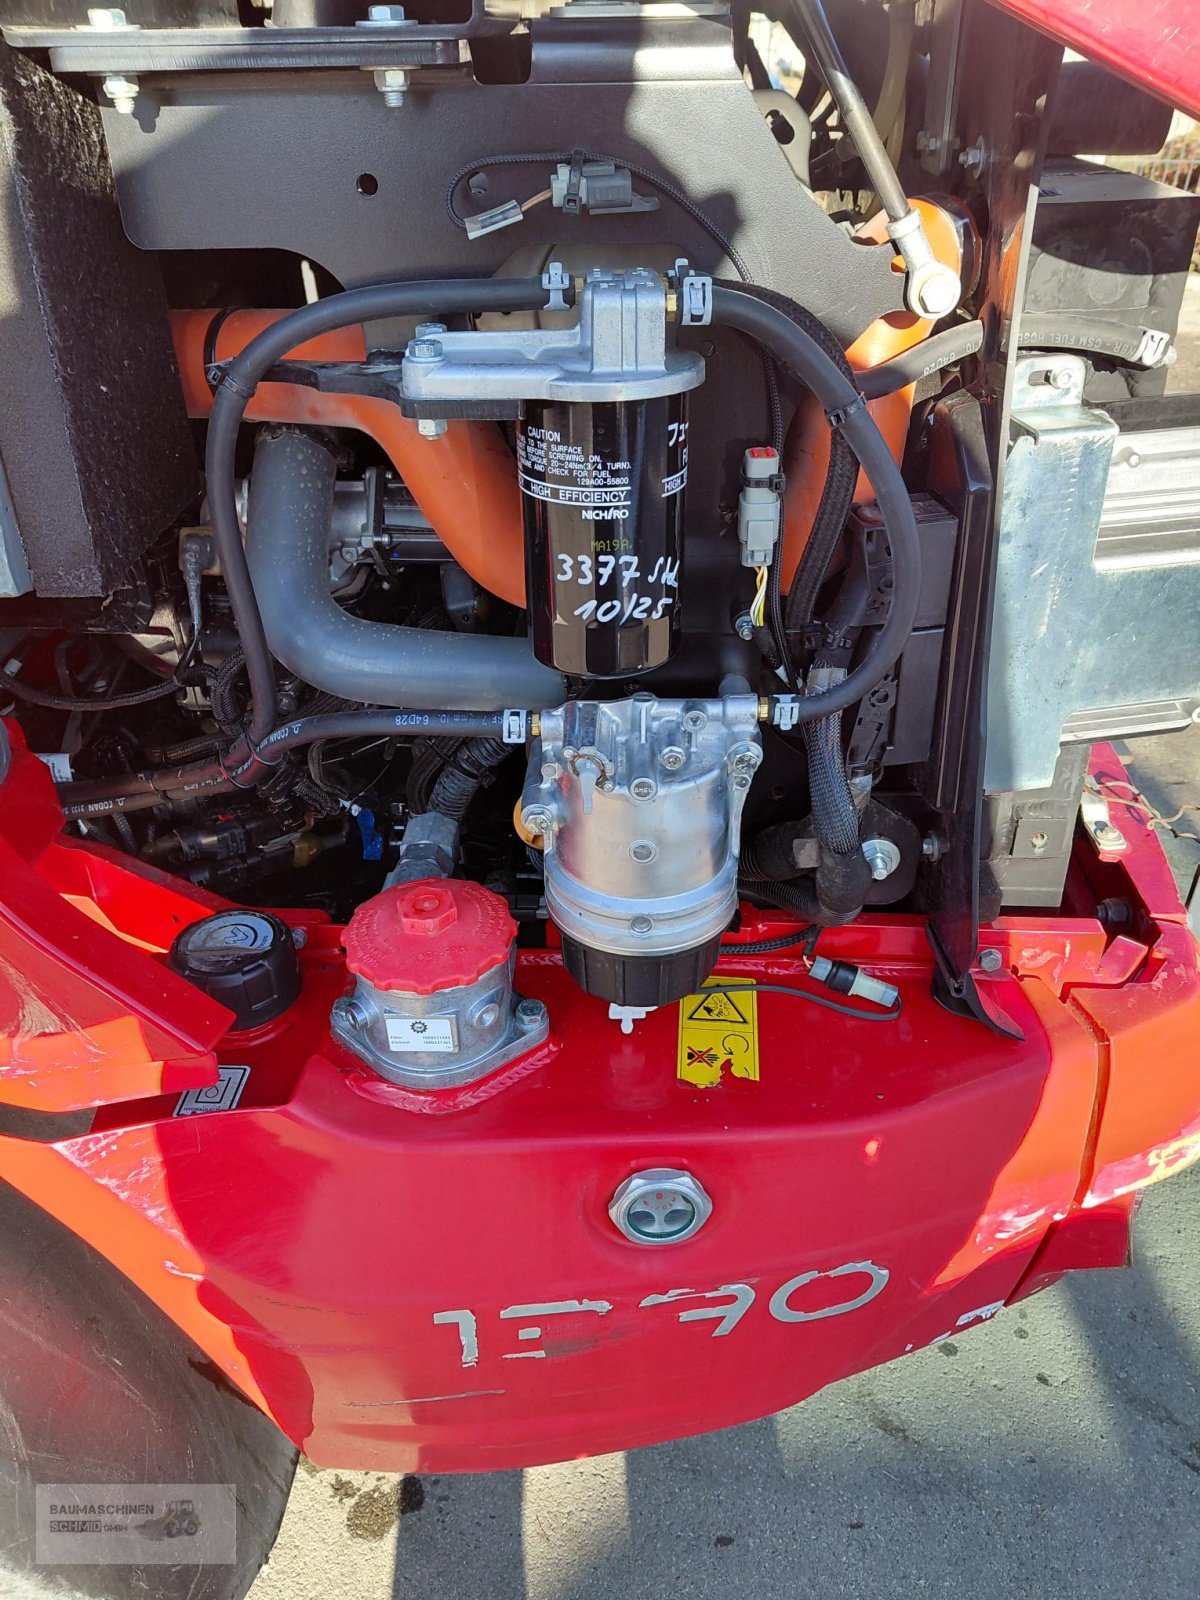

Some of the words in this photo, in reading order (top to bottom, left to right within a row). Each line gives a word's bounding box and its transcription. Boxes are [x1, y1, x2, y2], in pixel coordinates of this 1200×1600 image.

[1050, 332, 1075, 344] FUEL
[527, 426, 560, 442] CAUTION
[527, 445, 546, 457] BEFORE
[549, 451, 584, 462] SCREWING
[528, 438, 535, 447] TO
[537, 441, 547, 450] THE
[551, 444, 582, 454] SURFACE
[528, 453, 547, 465] TORQUE
[534, 464, 545, 473] AND
[548, 467, 569, 476] CHECK
[573, 470, 588, 478] FOR
[593, 470, 611, 478] FUEL
[531, 482, 551, 497] HIGH
[559, 490, 627, 502] EFFICIENCY
[664, 476, 681, 493] HIGH
[582, 507, 629, 520] NICHIRO
[556, 553, 640, 587] 3377
[573, 593, 673, 626] 10/25
[395, 713, 429, 726] 64D28
[88, 799, 113, 812] CODAN
